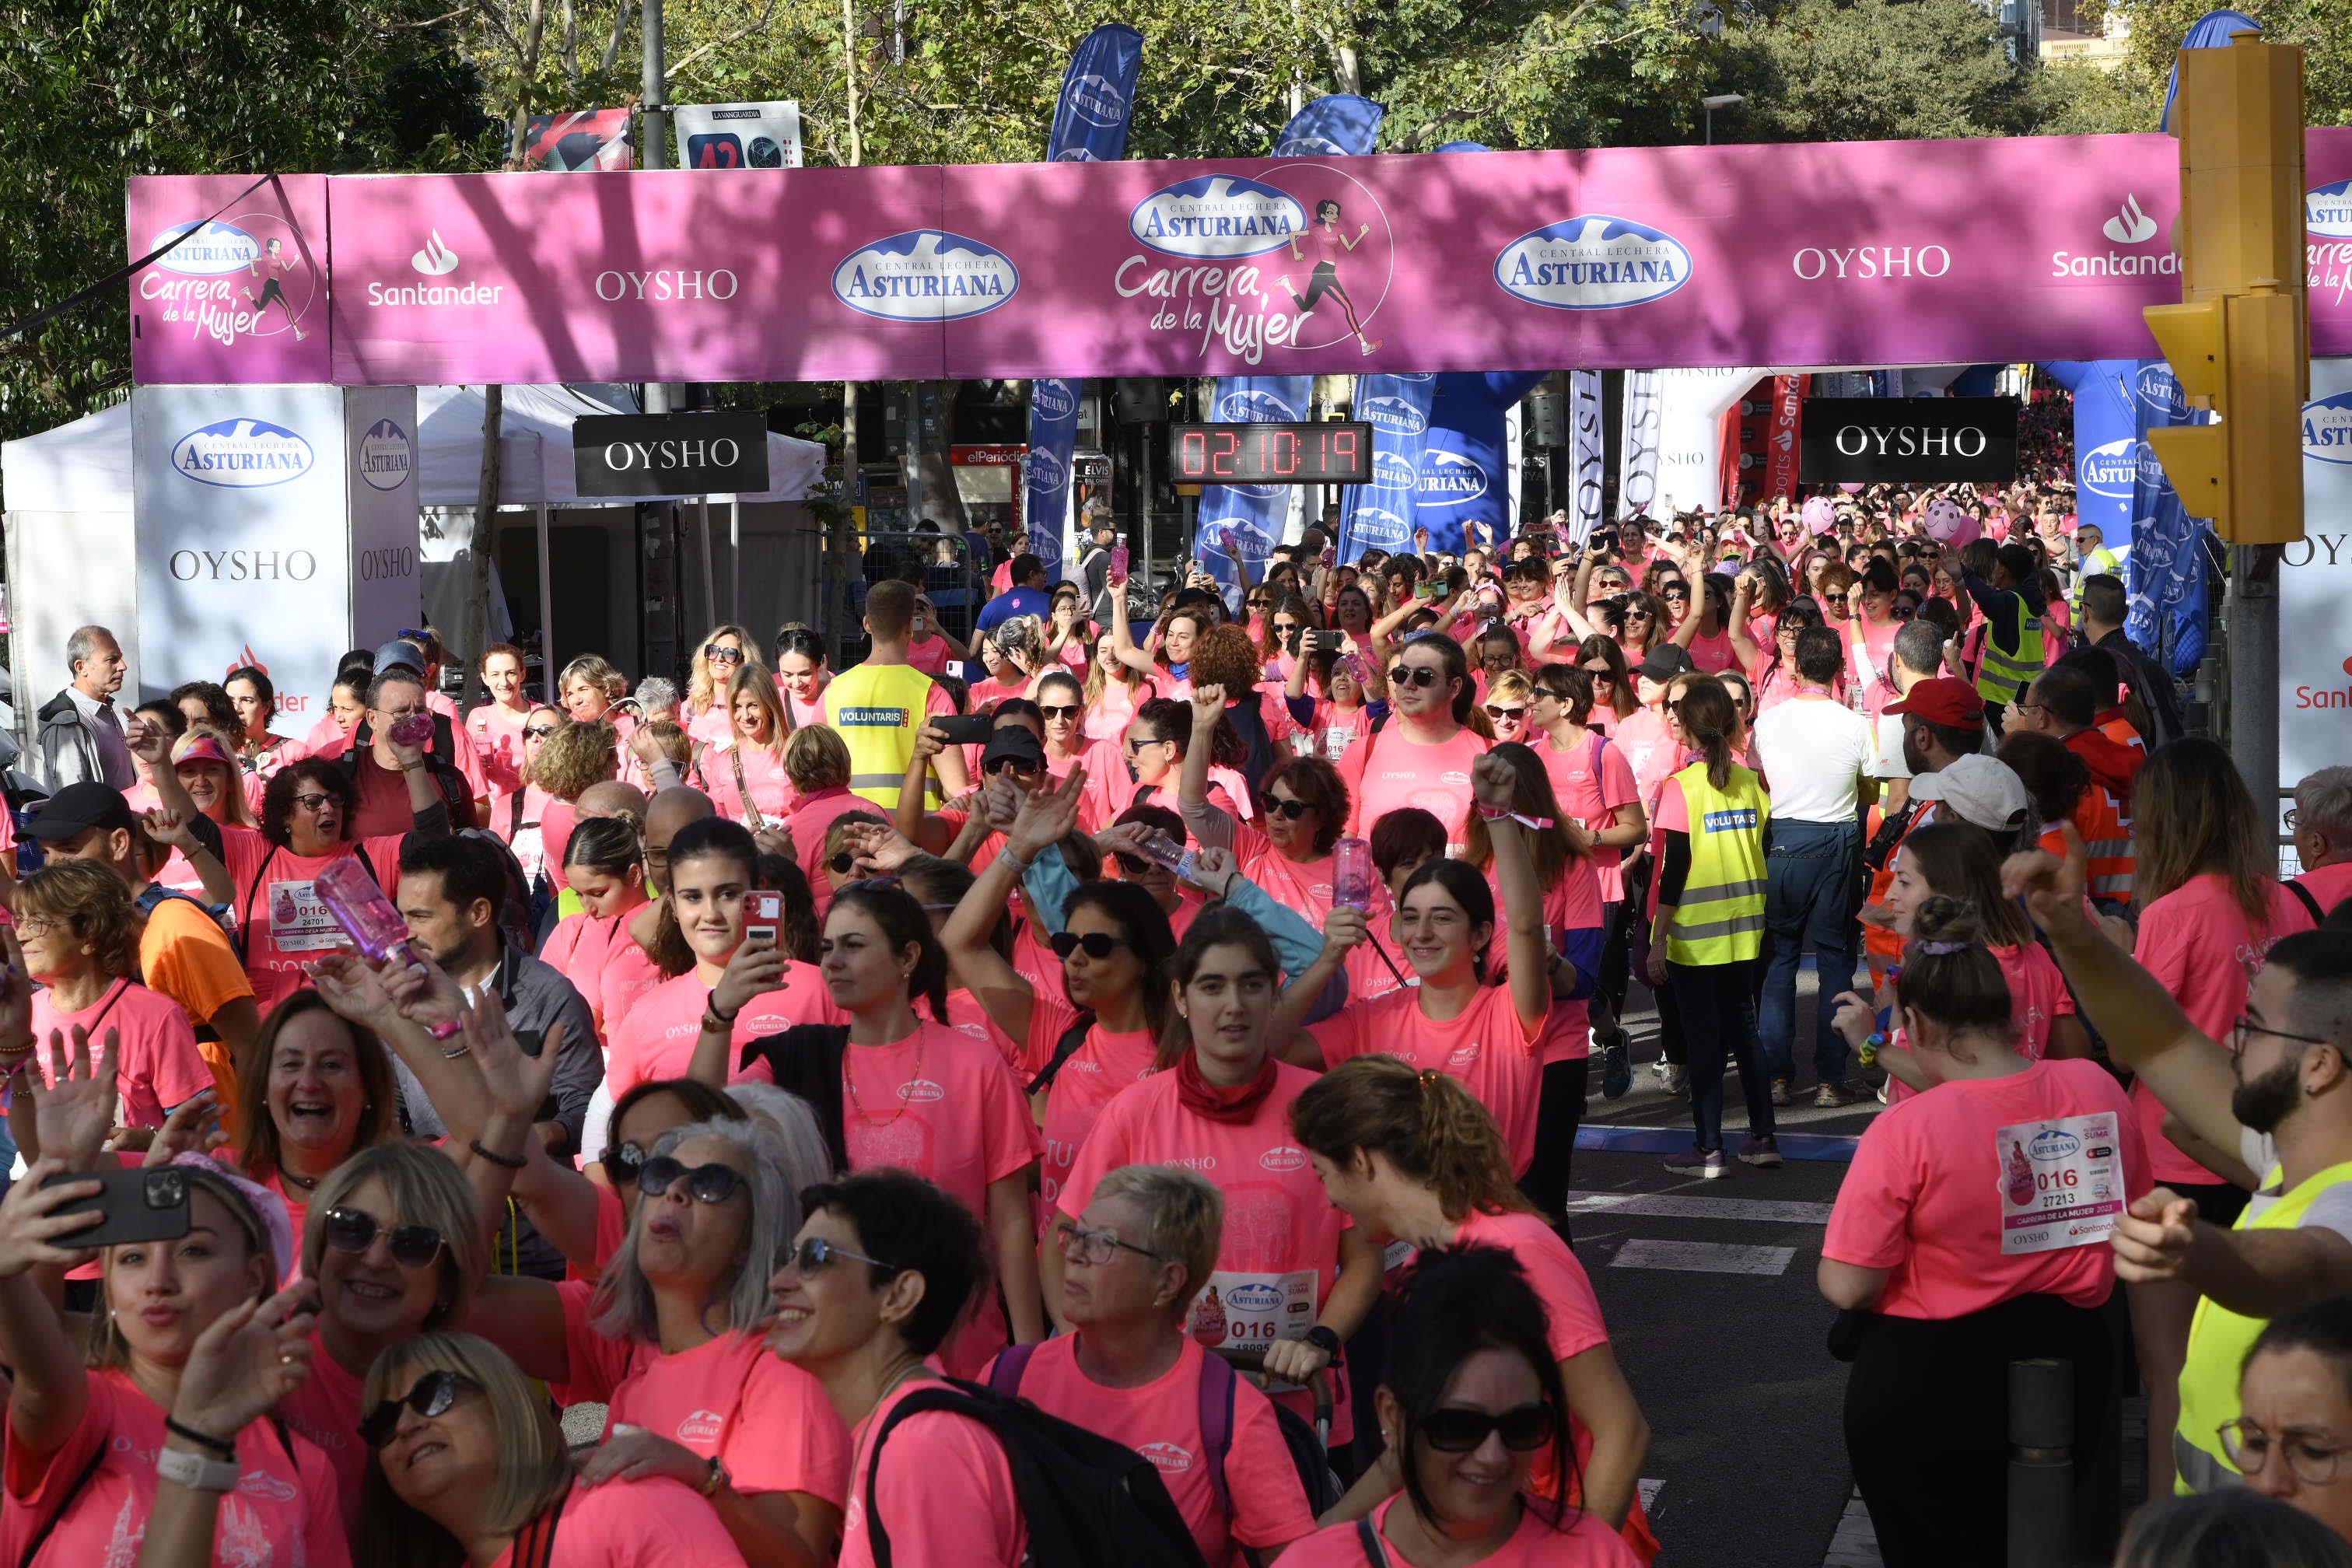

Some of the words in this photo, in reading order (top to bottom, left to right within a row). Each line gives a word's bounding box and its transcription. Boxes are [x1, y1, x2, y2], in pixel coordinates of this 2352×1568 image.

[1169, 203, 1225, 213] CENTRAL
[1230, 202, 1288, 212] LECHERA
[1143, 207, 1291, 238] ASTURIANA
[1540, 249, 1601, 258] CENTRAL
[1607, 246, 1671, 256] LECHERA
[1793, 245, 1951, 279] OYSHO
[875, 261, 934, 271] CENTRAL
[939, 261, 998, 270] LECHERA
[1115, 254, 1259, 298] Carrera
[1509, 251, 1677, 285] ASTURIANA
[2324, 266, 2339, 287] la
[140, 272, 231, 301] Carrera
[595, 268, 738, 301] OYSHO
[847, 264, 1004, 298] ASTURIANA
[368, 282, 504, 306] Santander
[162, 305, 180, 323] de
[182, 305, 195, 323] la
[194, 299, 266, 346] Mujer
[1150, 300, 1178, 331] de
[1182, 302, 1202, 331] la
[1199, 291, 1314, 366] Mujer
[1362, 405, 1420, 431] ASTURIANA
[1183, 432, 1357, 474] 02:10:19
[1836, 425, 1986, 457] OYSHO
[183, 444, 304, 471] ASTURIANA
[362, 446, 408, 473] ASTURIANA
[604, 438, 740, 471] OYSHO
[1085, 465, 1109, 476] ELVIS
[1352, 523, 1404, 541] STURIANA
[361, 546, 412, 581] OYSHO
[2280, 534, 2347, 568] OY
[170, 549, 317, 582] OYSHO
[840, 712, 901, 722] VOLUNTARIS
[299, 905, 328, 916] 016
[666, 1024, 702, 1040] OYSH
[2084, 1130, 2109, 1140] SUMA
[1047, 1139, 1073, 1167] TU
[2032, 1142, 2077, 1156] ASTURIANA
[2037, 1169, 2078, 1191] 016
[2042, 1193, 2075, 1207] 27213
[2017, 1215, 2048, 1225] CARRERA
[2068, 1208, 2095, 1217] MUJER
[2096, 1205, 2112, 1213] 2023
[2013, 1231, 2049, 1245] OYSHO
[1230, 1293, 1279, 1305] ASTURIANA
[1287, 1286, 1309, 1296] SUMA
[1231, 1321, 1276, 1338] 016
